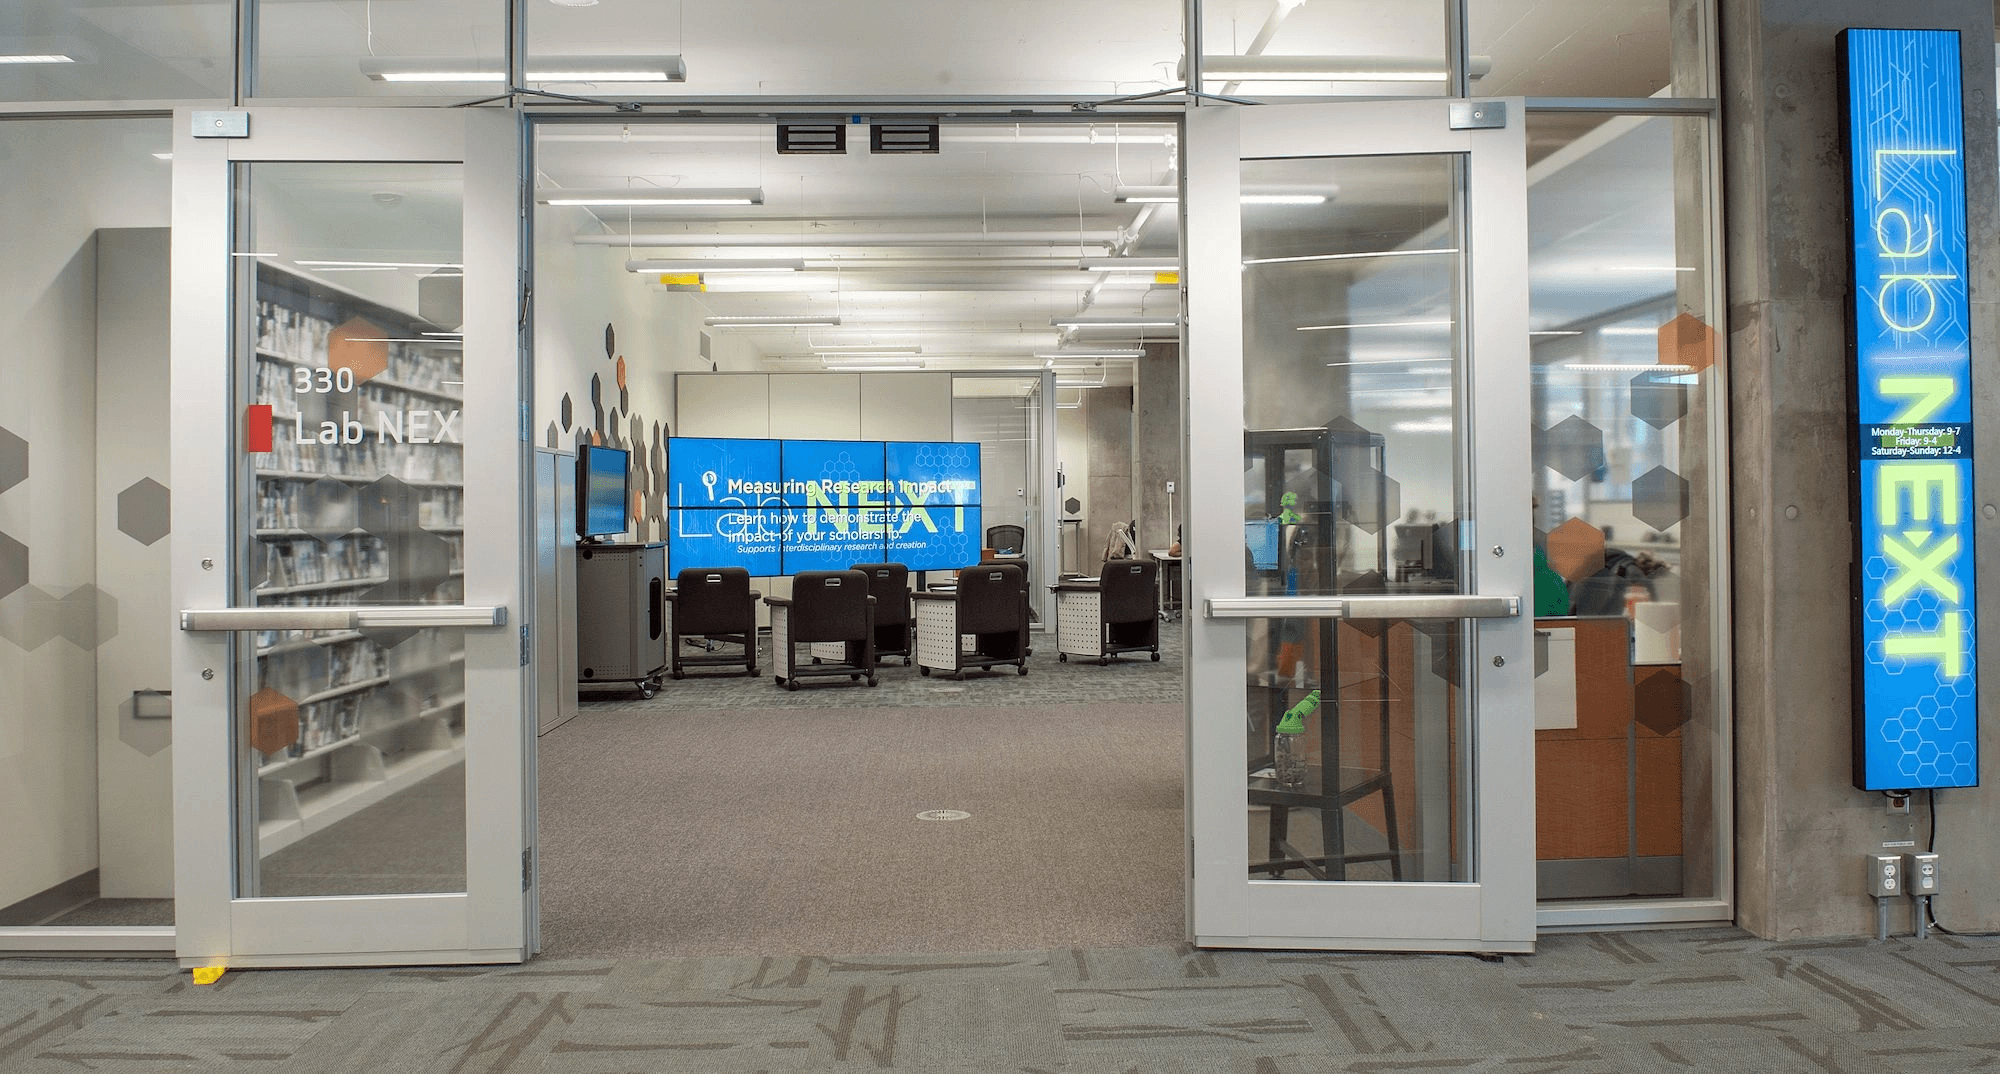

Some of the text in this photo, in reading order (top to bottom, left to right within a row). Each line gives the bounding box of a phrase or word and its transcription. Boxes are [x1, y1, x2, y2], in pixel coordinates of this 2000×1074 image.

[1875, 149, 1957, 333] Lab
[294, 367, 354, 393] 330
[296, 410, 459, 445] Lab NEX
[1871, 427, 1961, 438] Monday-Thursday: 9-7
[1895, 437, 1938, 447] Friday: 9-4
[1871, 446, 1962, 457] Saturday-Sunday: 12-4
[727, 478, 952, 498] Measuring Research Impact
[806, 480, 976, 534] NEXT
[728, 510, 922, 525] Learn how to demonstrate the
[728, 527, 902, 544] impact of your scholarship.
[1878, 378, 1960, 678] NEXT
[737, 544, 776, 553] Supports
[844, 541, 878, 551] research
[896, 540, 927, 549] creation
